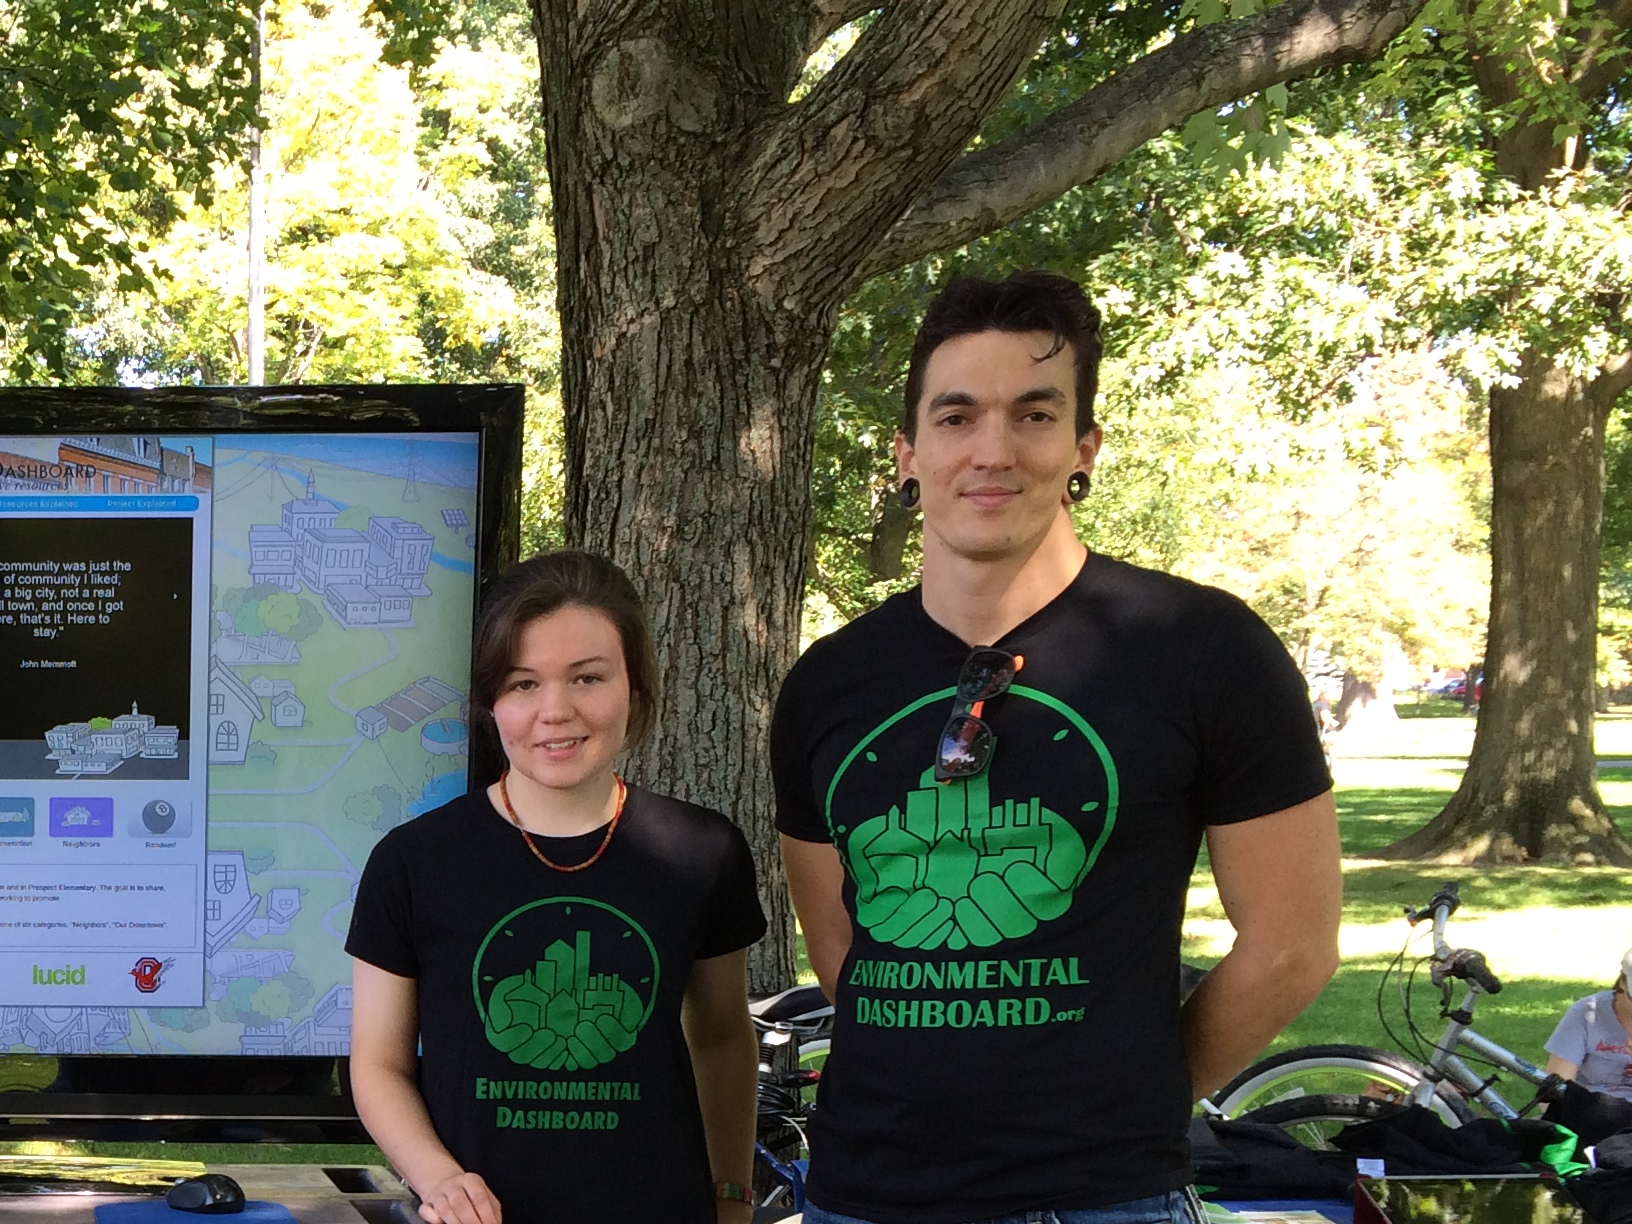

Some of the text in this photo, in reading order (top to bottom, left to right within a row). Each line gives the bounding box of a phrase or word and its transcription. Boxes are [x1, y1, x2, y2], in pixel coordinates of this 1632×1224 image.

[14, 482, 68, 490] resources
[40, 500, 79, 509] Explained
[137, 500, 176, 509] Explained
[63, 562, 87, 572] was
[88, 560, 110, 574] just
[113, 560, 132, 572] the
[3, 574, 16, 585] of
[18, 574, 81, 587] community
[83, 574, 88, 585] I
[4, 589, 12, 598] a
[14, 587, 32, 600] big
[35, 587, 58, 600] city,
[60, 588, 79, 598] not
[82, 589, 90, 598] a
[93, 587, 115, 598] real
[7, 601, 39, 613] town,
[42, 600, 63, 611] and
[66, 602, 95, 611] once
[98, 601, 102, 611] I
[105, 601, 124, 614] got
[19, 613, 51, 624] that's
[53, 614, 64, 624] it.
[67, 614, 96, 624] Here
[98, 614, 110, 624] to
[33, 626, 65, 640] stay."
[19, 659, 39, 669] John
[62, 840, 100, 848] Neighbors
[32, 964, 86, 986] lucid
[848, 956, 1090, 990] ENVIRONMENTAL
[856, 996, 1086, 1029] DASHBOARD.org
[475, 1077, 642, 1101] ENVIRONMENTAL
[495, 1106, 620, 1130] DASHBOARD
